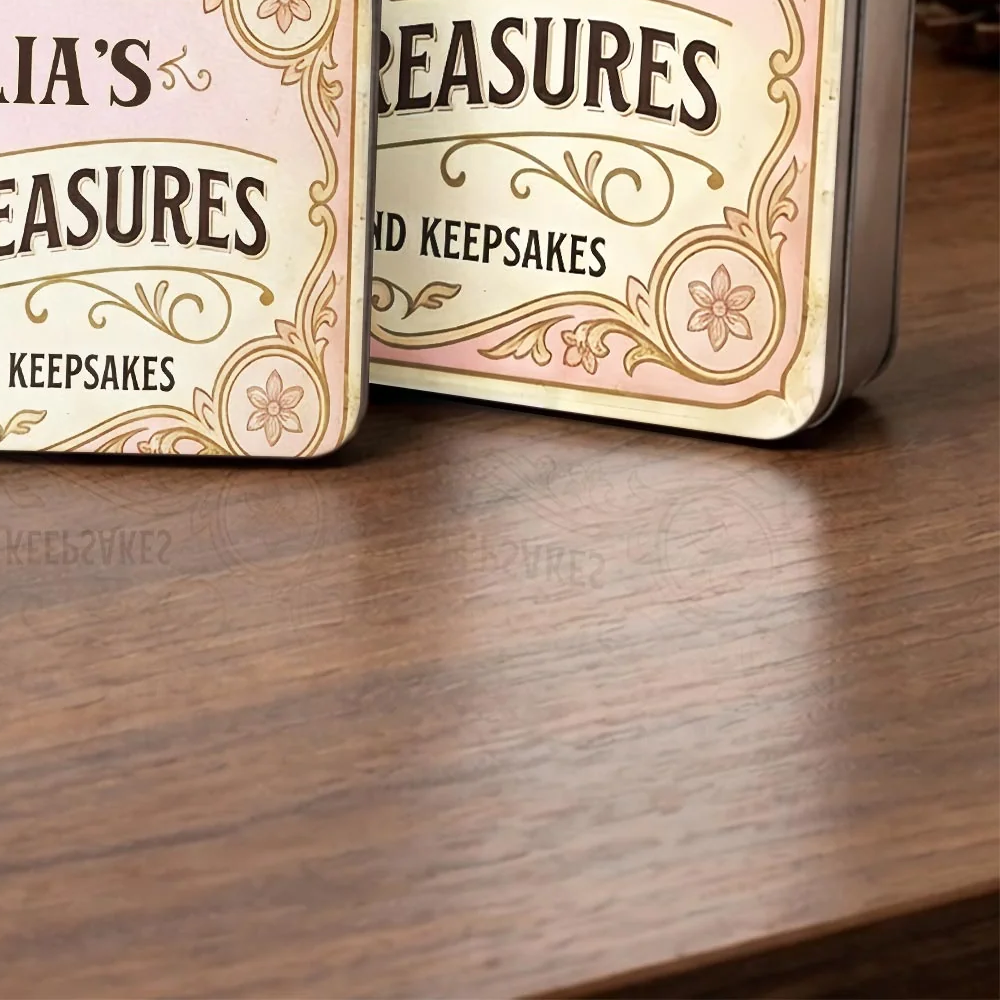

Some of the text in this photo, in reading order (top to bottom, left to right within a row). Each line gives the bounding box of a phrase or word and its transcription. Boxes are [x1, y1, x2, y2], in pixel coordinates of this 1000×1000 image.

[379, 16, 719, 133] EASURES
[420, 216, 607, 278] KEEPSAKES
[8, 352, 176, 392] KEEPSAKES
